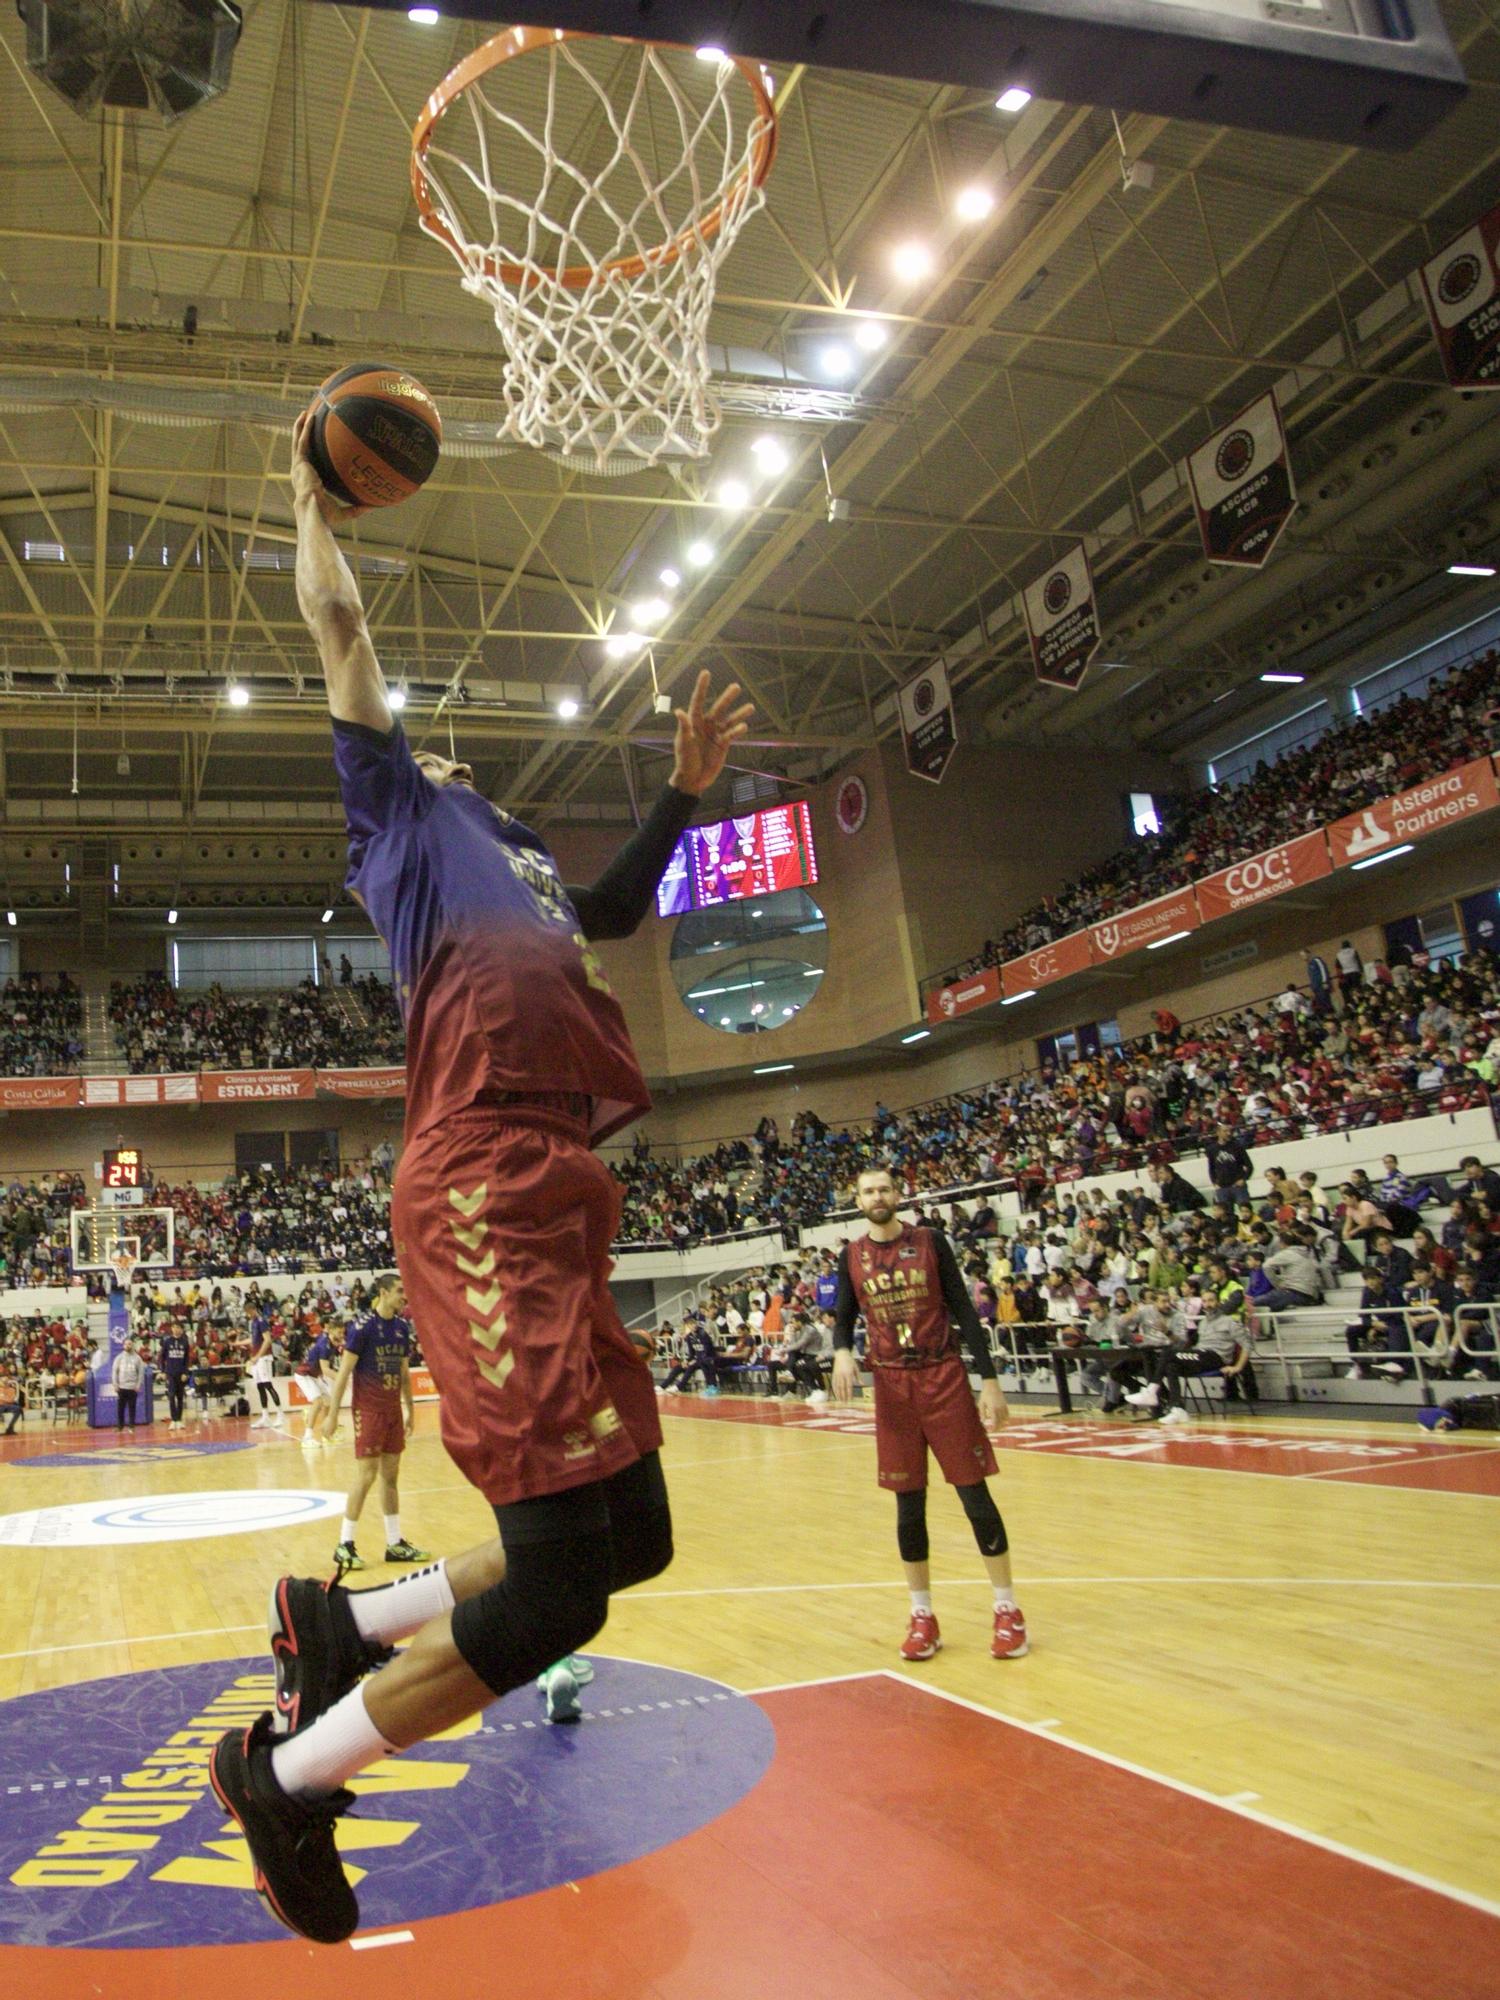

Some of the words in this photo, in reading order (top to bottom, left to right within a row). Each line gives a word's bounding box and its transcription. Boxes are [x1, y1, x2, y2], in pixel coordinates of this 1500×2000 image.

[1221, 474, 1269, 515] ASCENSO
[1391, 775, 1463, 817] Asterra
[1393, 792, 1480, 838] Partners
[109, 1165, 137, 1187] 24
[862, 1268, 927, 1296] UCAM
[867, 1287, 929, 1307] UNIVERSIDAD
[1093, 1427, 1418, 1457] Deportes
